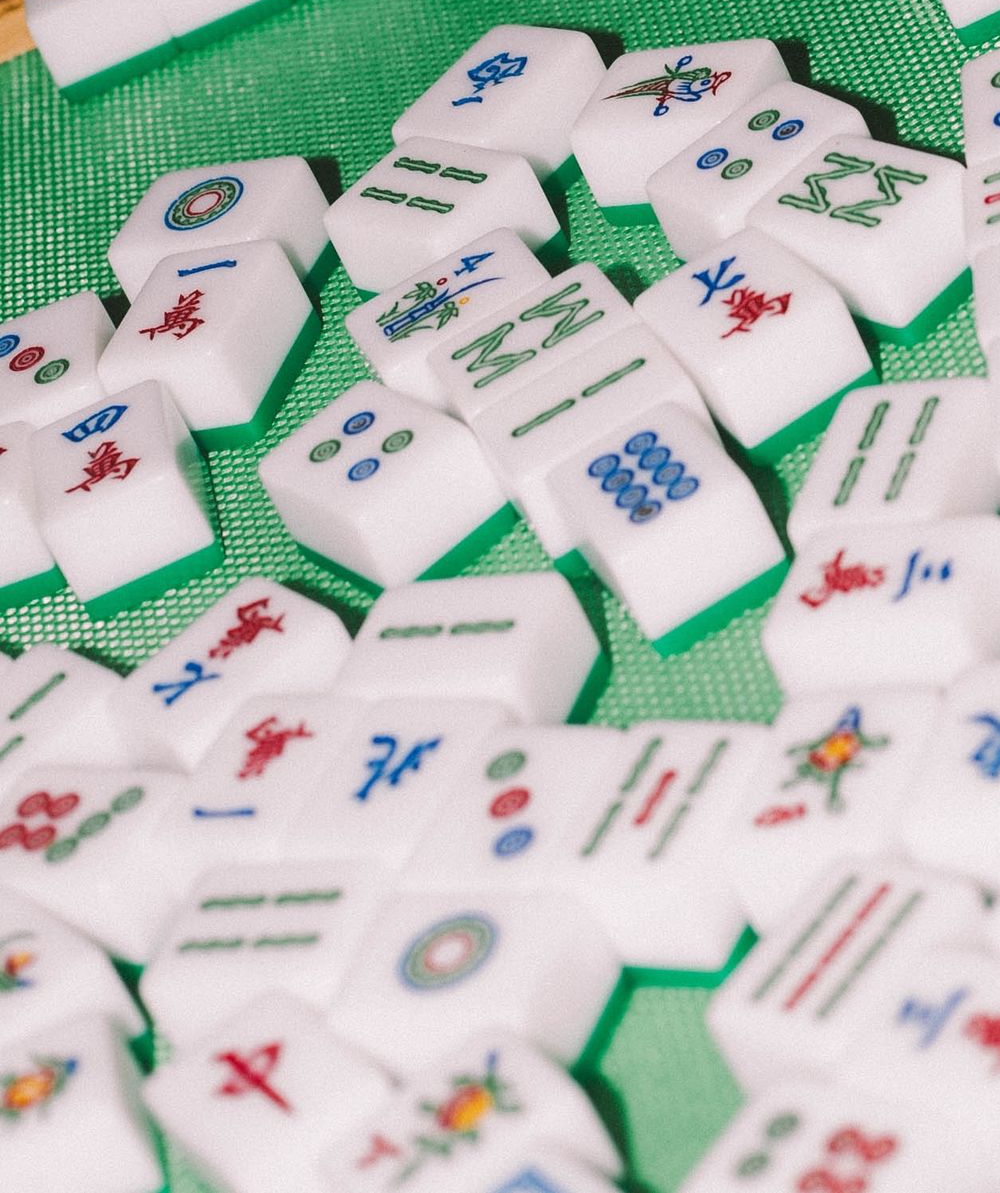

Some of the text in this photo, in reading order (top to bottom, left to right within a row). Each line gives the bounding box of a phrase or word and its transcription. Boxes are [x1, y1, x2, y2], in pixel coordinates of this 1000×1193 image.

[452, 51, 528, 107] 西
[141, 259, 237, 339] 一萬
[692, 256, 792, 338] 七萬
[62, 403, 139, 493] 四萬
[800, 550, 952, 609] 三萬
[151, 597, 283, 706] 七萬
[192, 716, 312, 818] 一萬
[354, 734, 441, 803] 北
[212, 1040, 293, 1114] 中
